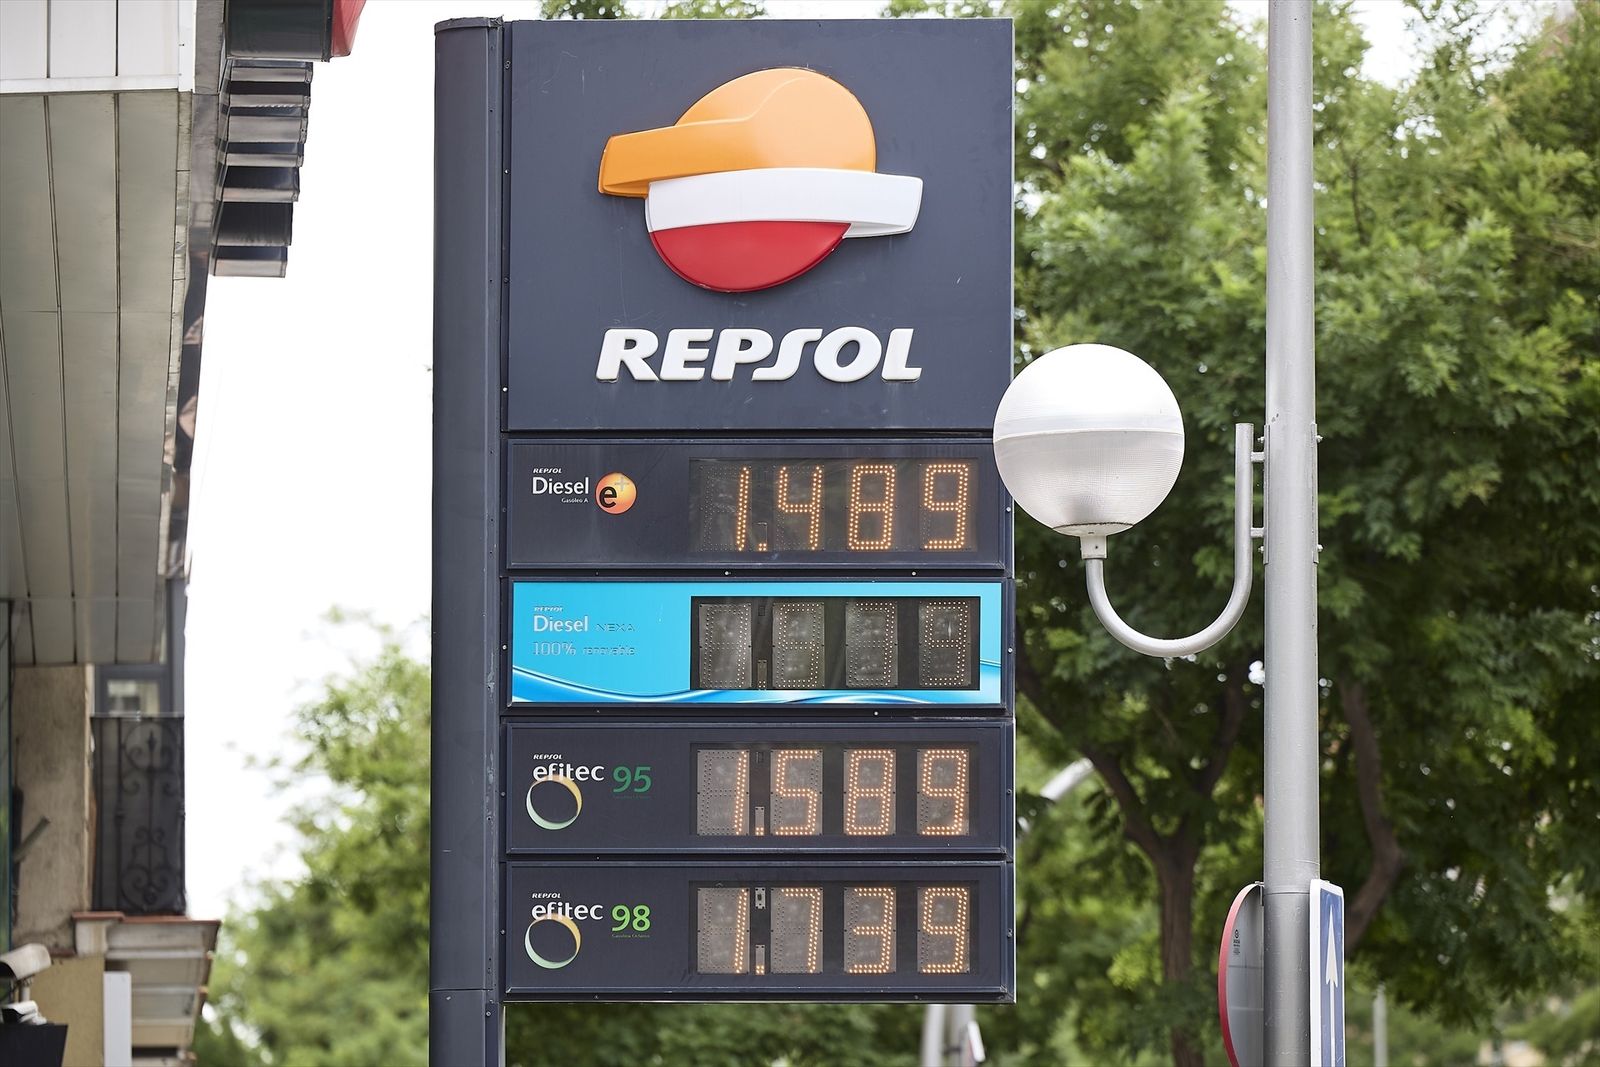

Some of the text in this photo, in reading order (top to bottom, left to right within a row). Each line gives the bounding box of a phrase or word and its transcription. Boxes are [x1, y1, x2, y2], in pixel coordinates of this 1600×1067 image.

[596, 327, 923, 383] REPSOL
[532, 477, 589, 494] Diesel
[736, 464, 969, 551] 1.489
[533, 615, 635, 632] Diesel NEXA
[533, 642, 576, 655] 100%
[533, 763, 652, 793] efitec 95
[735, 749, 968, 836] 1.589
[531, 902, 651, 931] efitec 98
[735, 887, 968, 974] 1.739
